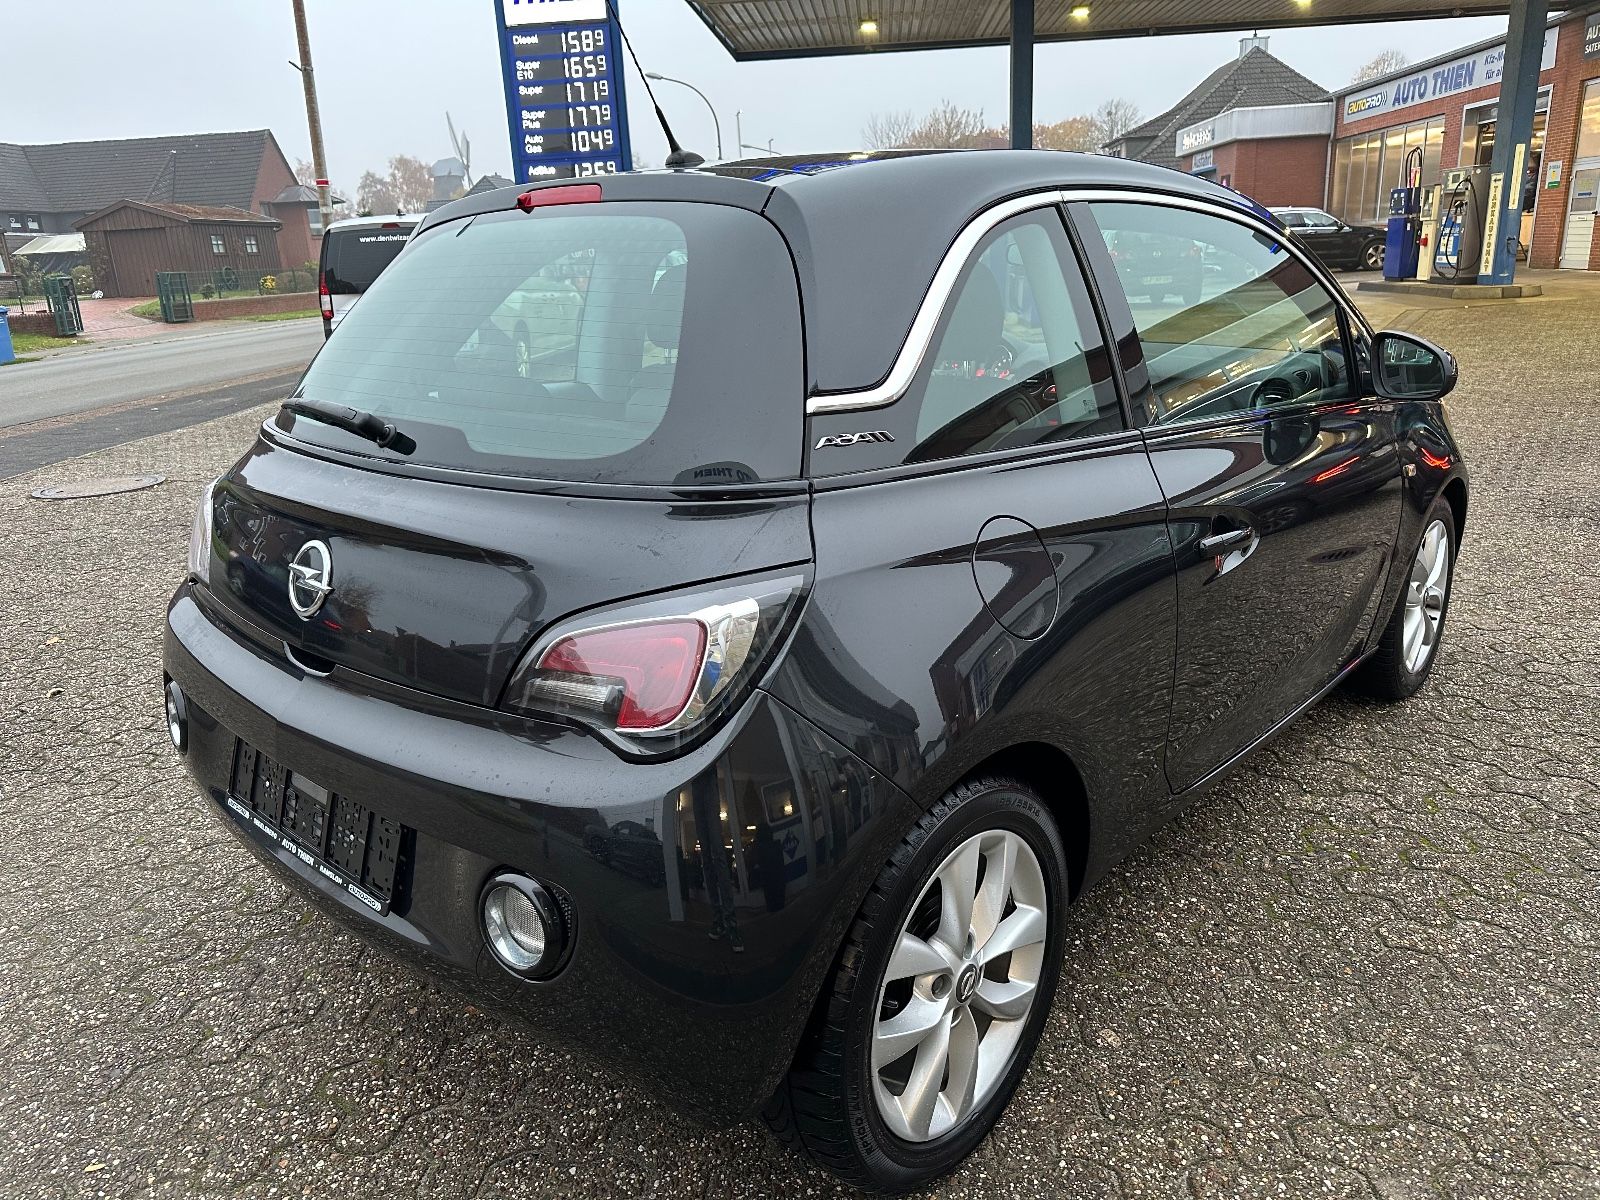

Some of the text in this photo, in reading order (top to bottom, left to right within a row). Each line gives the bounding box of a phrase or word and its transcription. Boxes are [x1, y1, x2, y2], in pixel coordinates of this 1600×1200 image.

[513, 35, 538, 45] Diesel
[516, 60, 540, 70] Super
[517, 70, 533, 80] E10
[1392, 76, 1428, 107] AUTO
[1432, 60, 1476, 96] THIEN
[519, 86, 543, 96] Super
[521, 110, 545, 120] Super
[522, 120, 540, 129] Plus
[525, 135, 543, 144] Auto
[525, 144, 542, 153] Gas
[281, 838, 297, 854] AUTO
